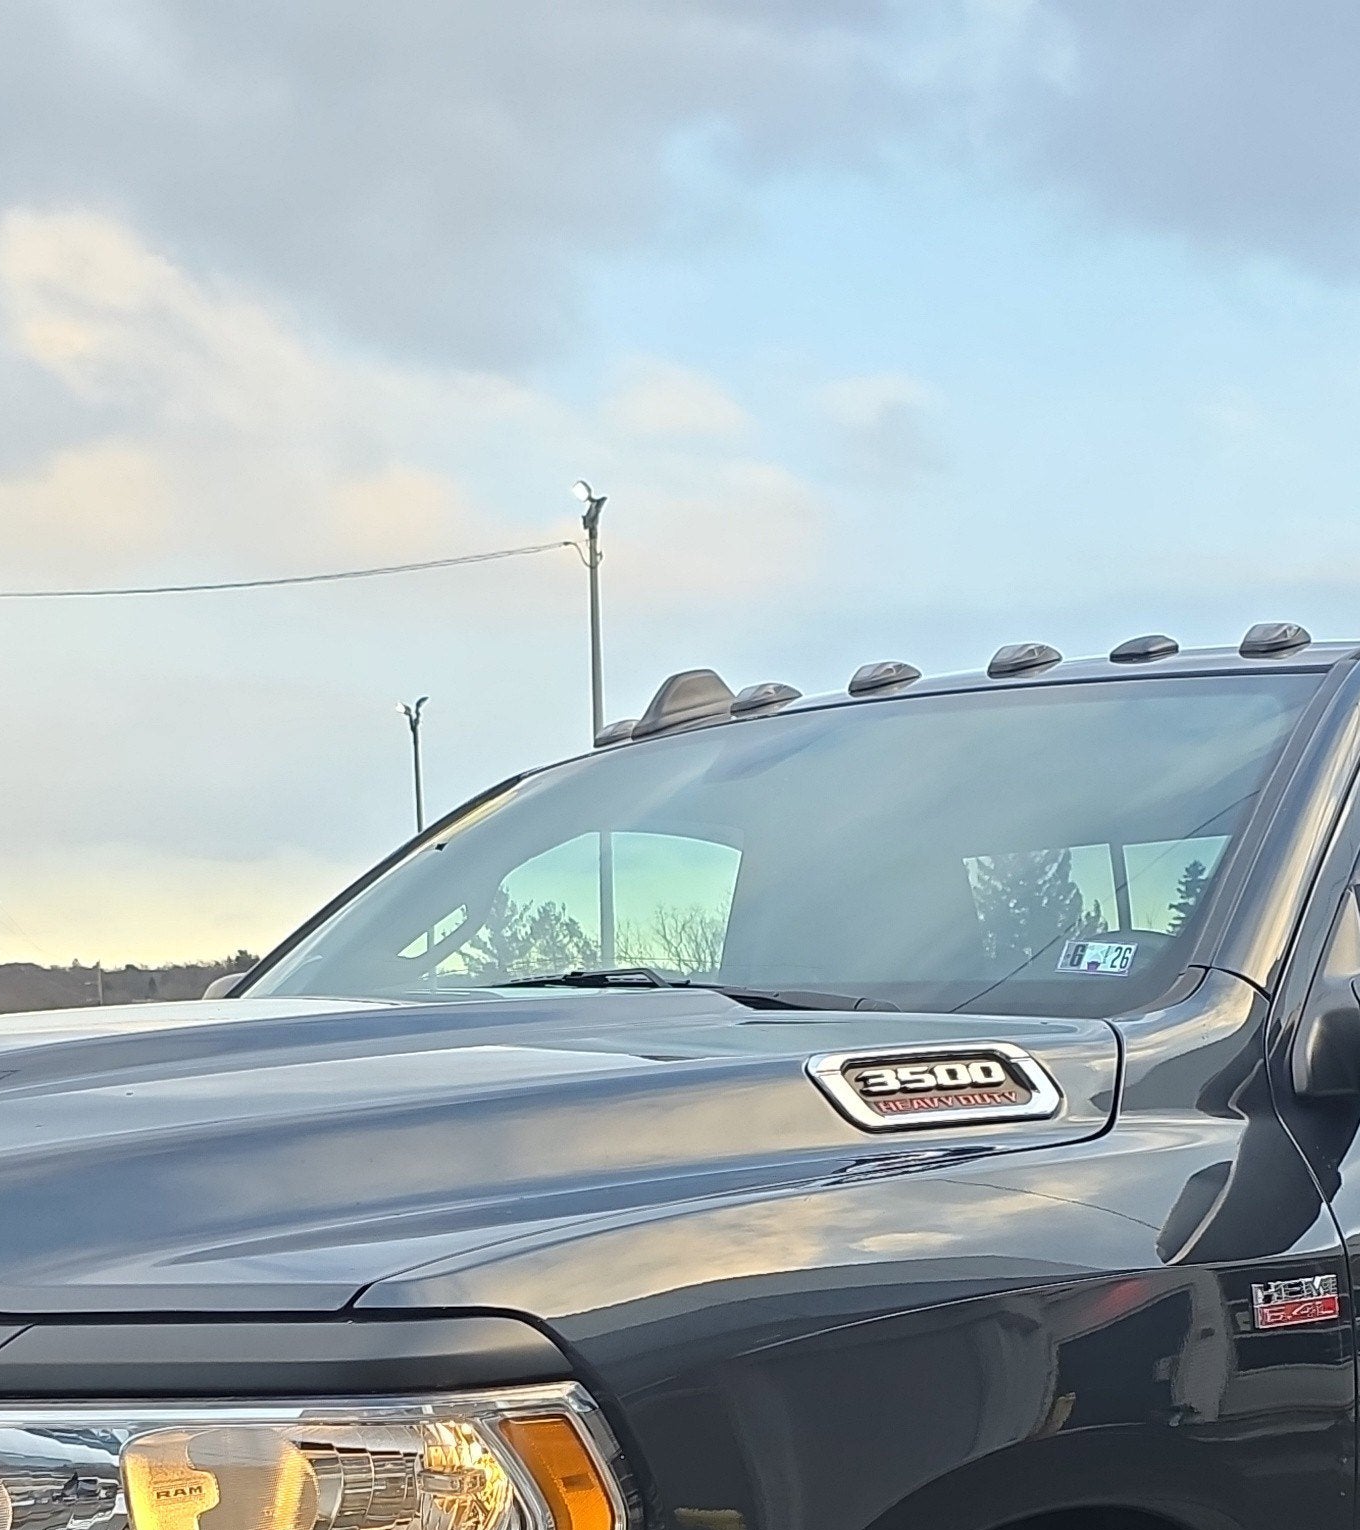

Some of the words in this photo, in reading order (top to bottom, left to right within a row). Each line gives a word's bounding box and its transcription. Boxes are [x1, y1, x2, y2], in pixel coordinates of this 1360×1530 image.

[1109, 946, 1132, 969] 26
[857, 1060, 1007, 1096] 3500
[875, 1096, 954, 1114] HEAVY
[958, 1090, 1019, 1108] DUTY
[1251, 1274, 1338, 1306] HEMI
[156, 1485, 203, 1500] RAM
